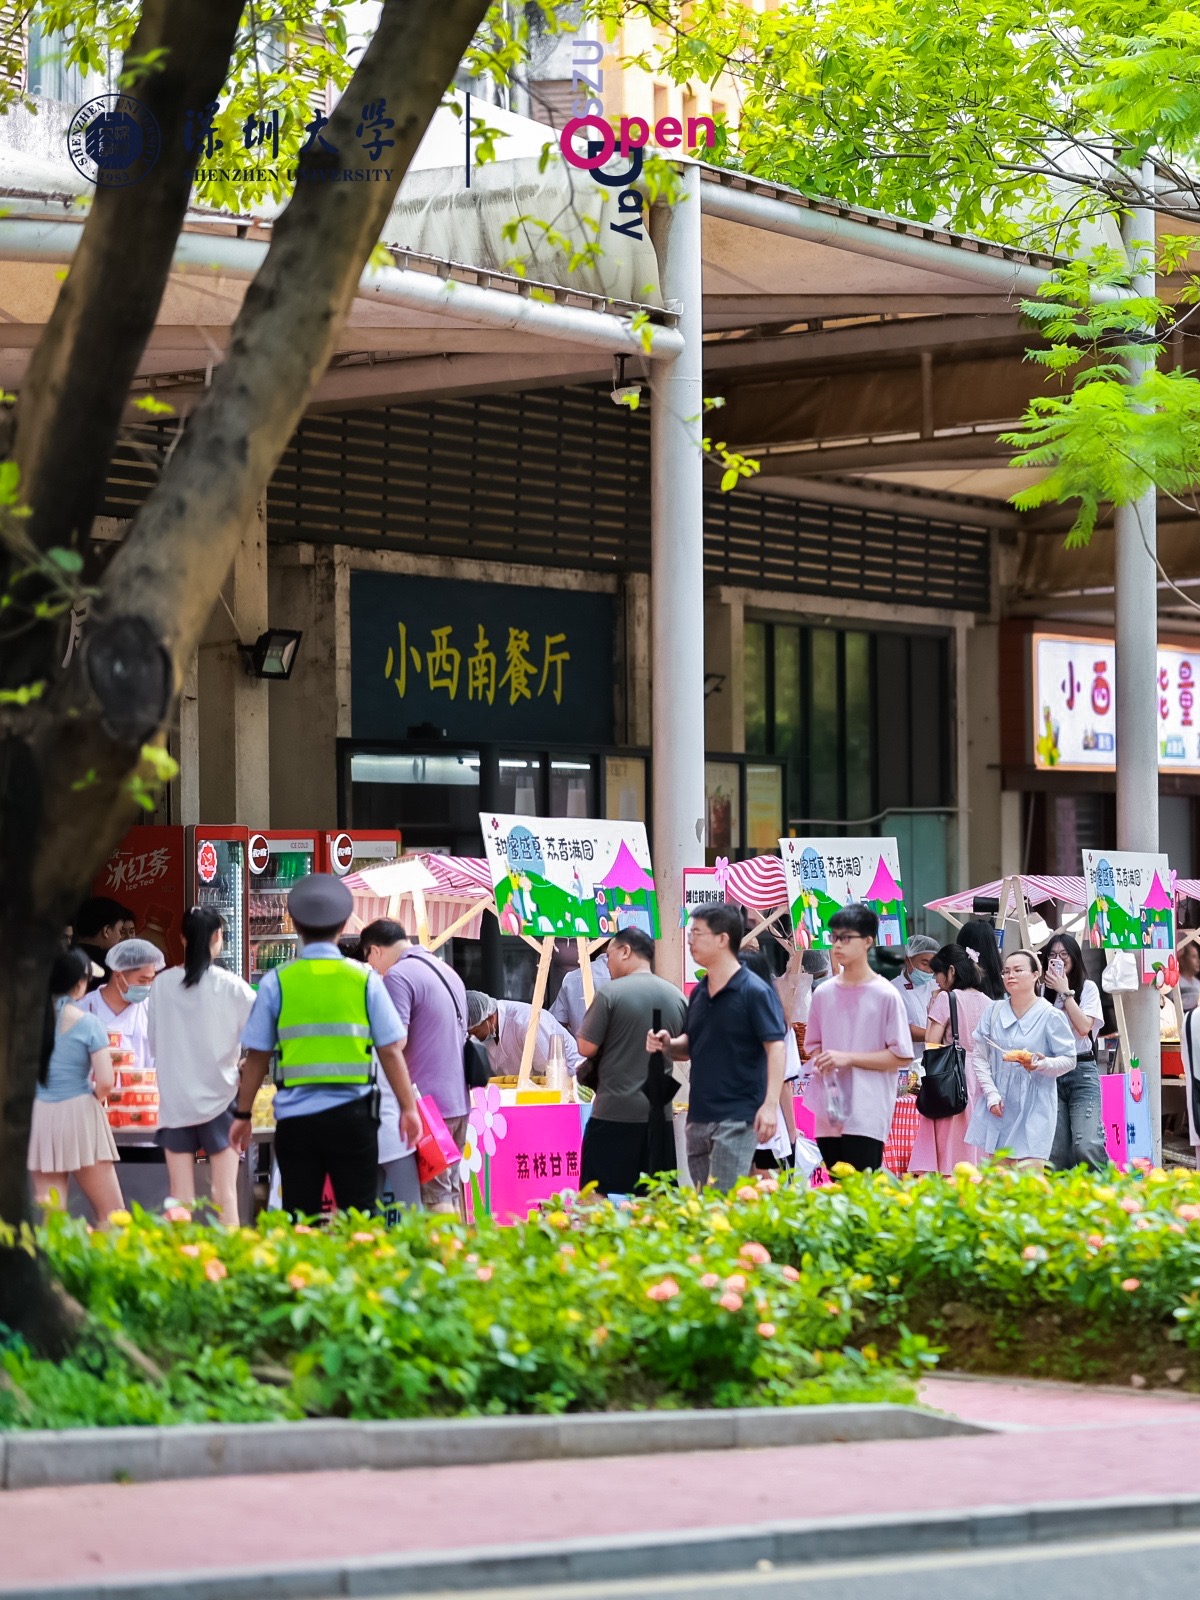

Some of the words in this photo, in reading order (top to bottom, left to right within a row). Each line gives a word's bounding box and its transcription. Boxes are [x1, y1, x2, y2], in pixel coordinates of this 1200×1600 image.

[385, 621, 570, 706] 小西南餐厅
[290, 841, 299, 849] ICE
[300, 841, 309, 849] COLD
[106, 847, 172, 892] 冰红茶
[126, 882, 138, 891] Ice
[140, 878, 155, 886] Tea
[516, 1151, 580, 1179] 荔枝甘蔗
